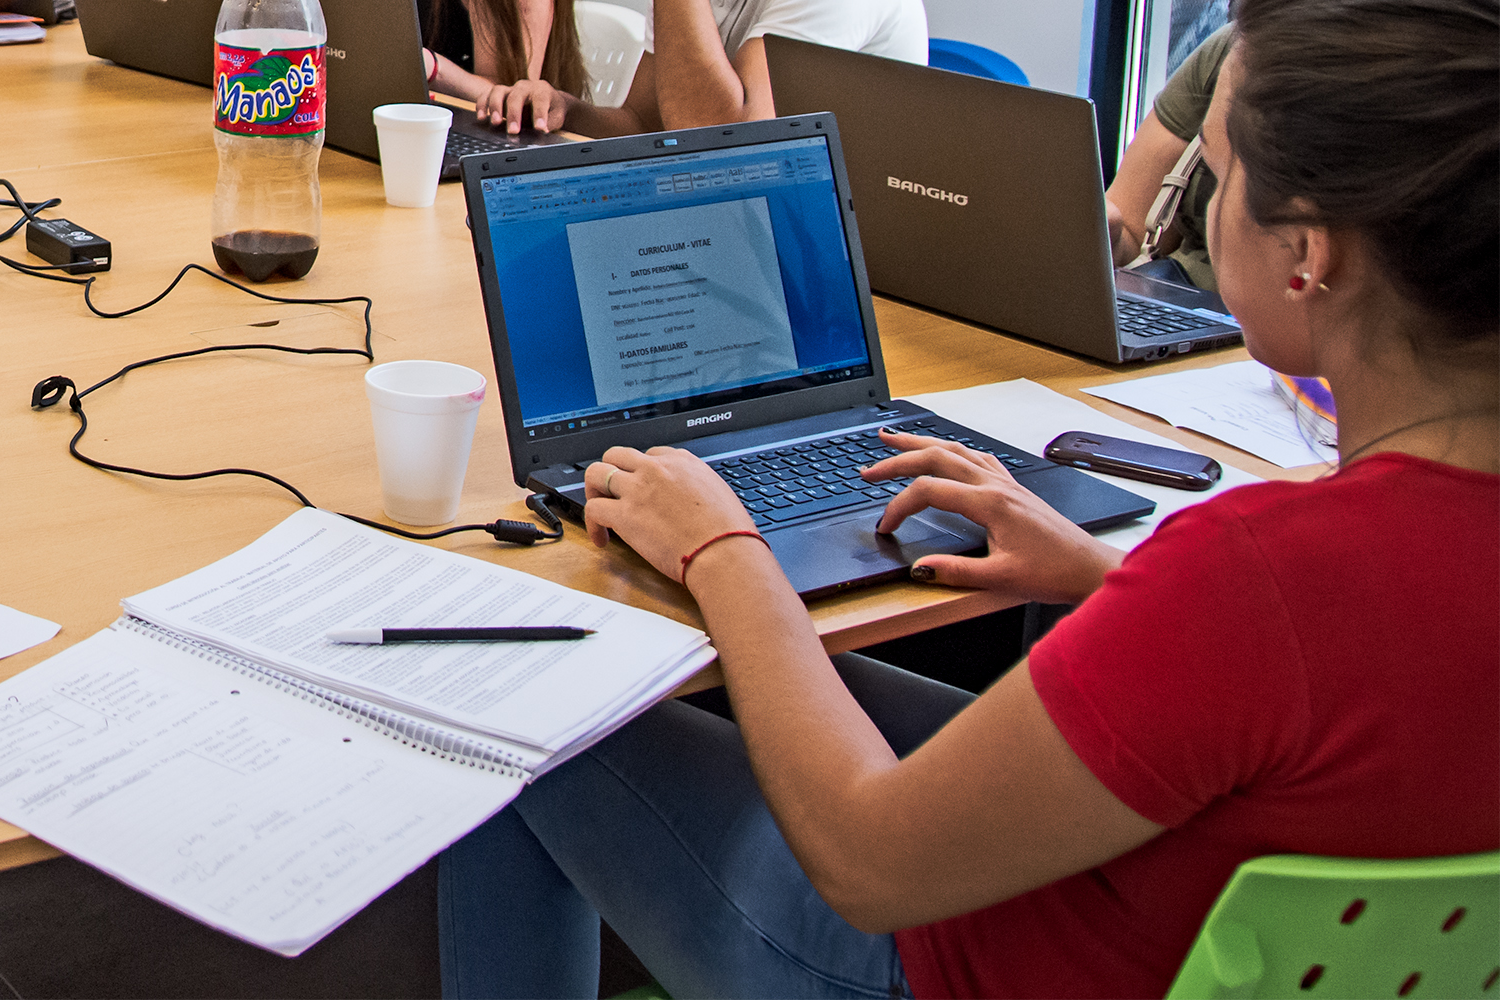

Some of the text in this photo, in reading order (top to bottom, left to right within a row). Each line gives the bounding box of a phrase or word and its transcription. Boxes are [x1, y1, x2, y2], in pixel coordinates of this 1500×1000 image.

[216, 54, 317, 123] Manaos
[638, 241, 686, 257] CURRICULUM
[690, 237, 712, 249] VITAE
[630, 267, 652, 279] DATOS
[651, 262, 690, 275] PERSONALES
